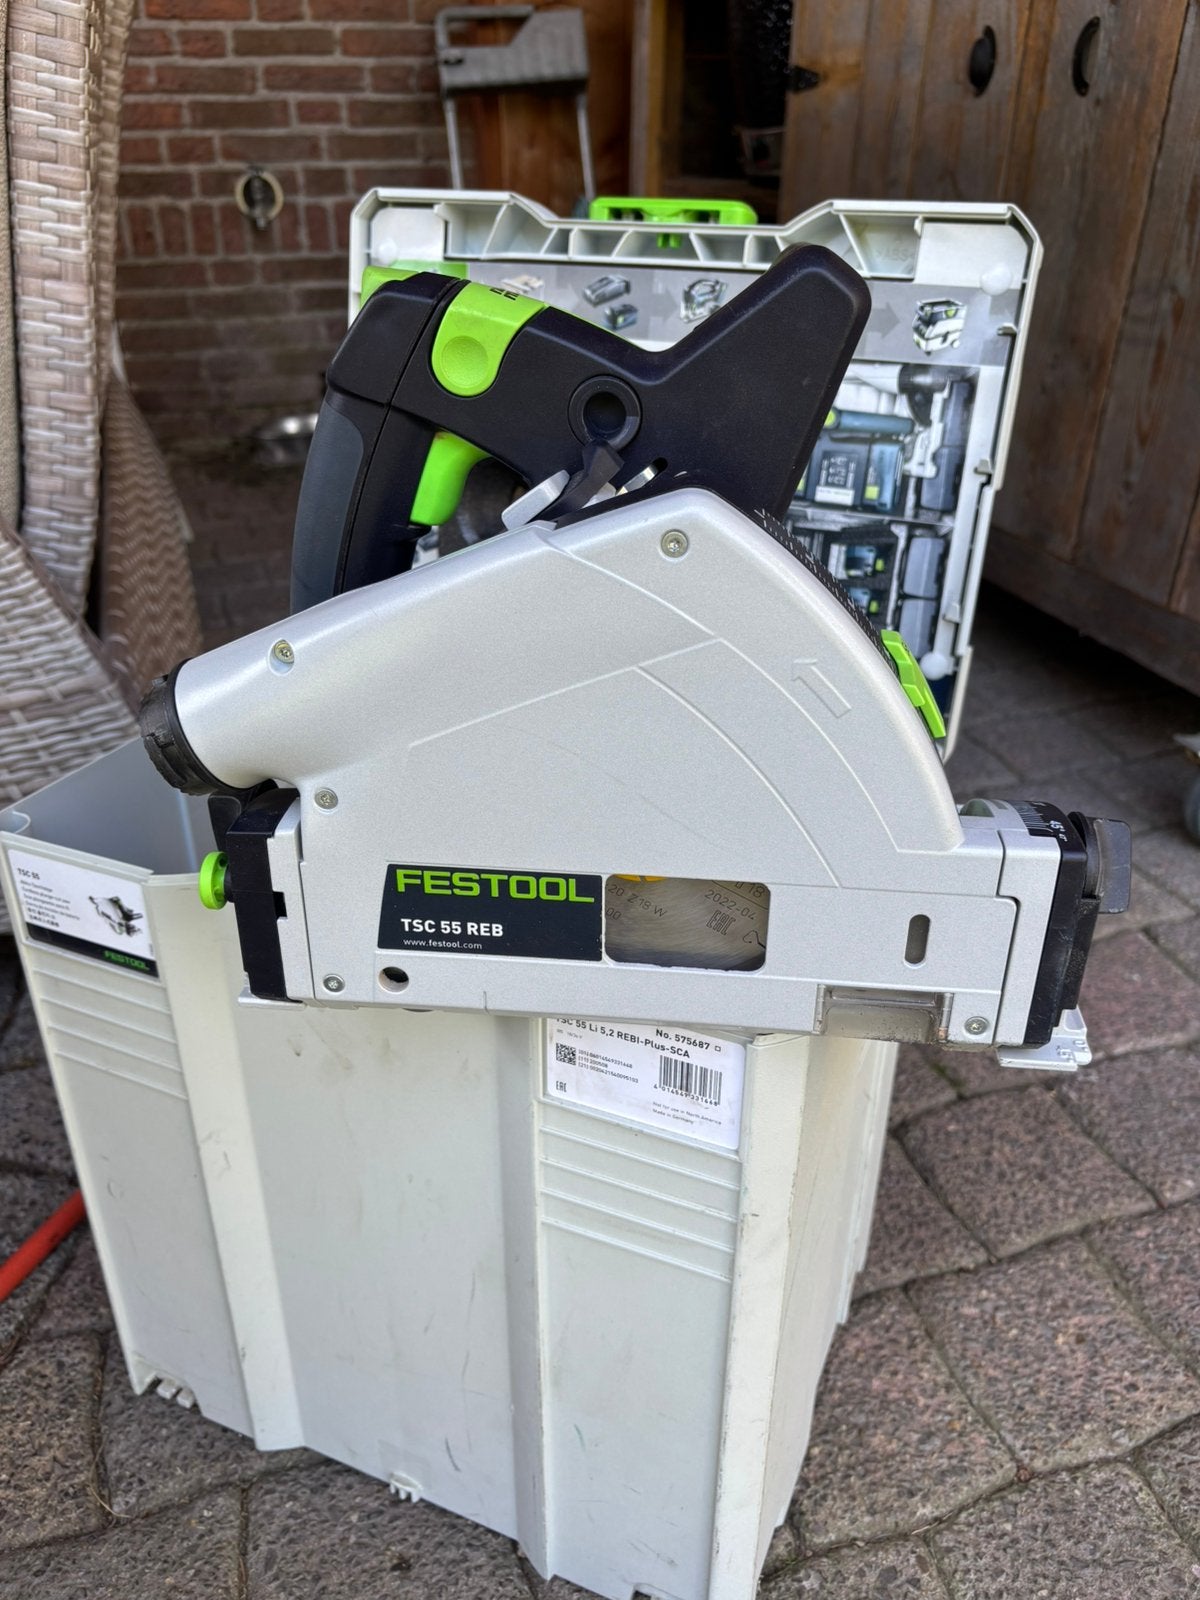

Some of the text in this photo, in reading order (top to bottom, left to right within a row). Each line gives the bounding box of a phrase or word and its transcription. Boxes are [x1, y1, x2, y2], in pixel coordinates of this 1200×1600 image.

[396, 868, 594, 902] FESTOOL
[606, 884, 624, 896] 20
[704, 889, 757, 920] 2022-04
[400, 918, 504, 937] TSC 55 REB
[403, 938, 482, 950] www.festool.com
[104, 950, 150, 970] FESTOOL
[576, 1020, 586, 1029] 55
[589, 1024, 598, 1032] Li
[616, 1031, 690, 1058] REBI-Plus-SCA
[656, 1028, 710, 1050] No. 575687
[672, 1114, 694, 1124] Germany
